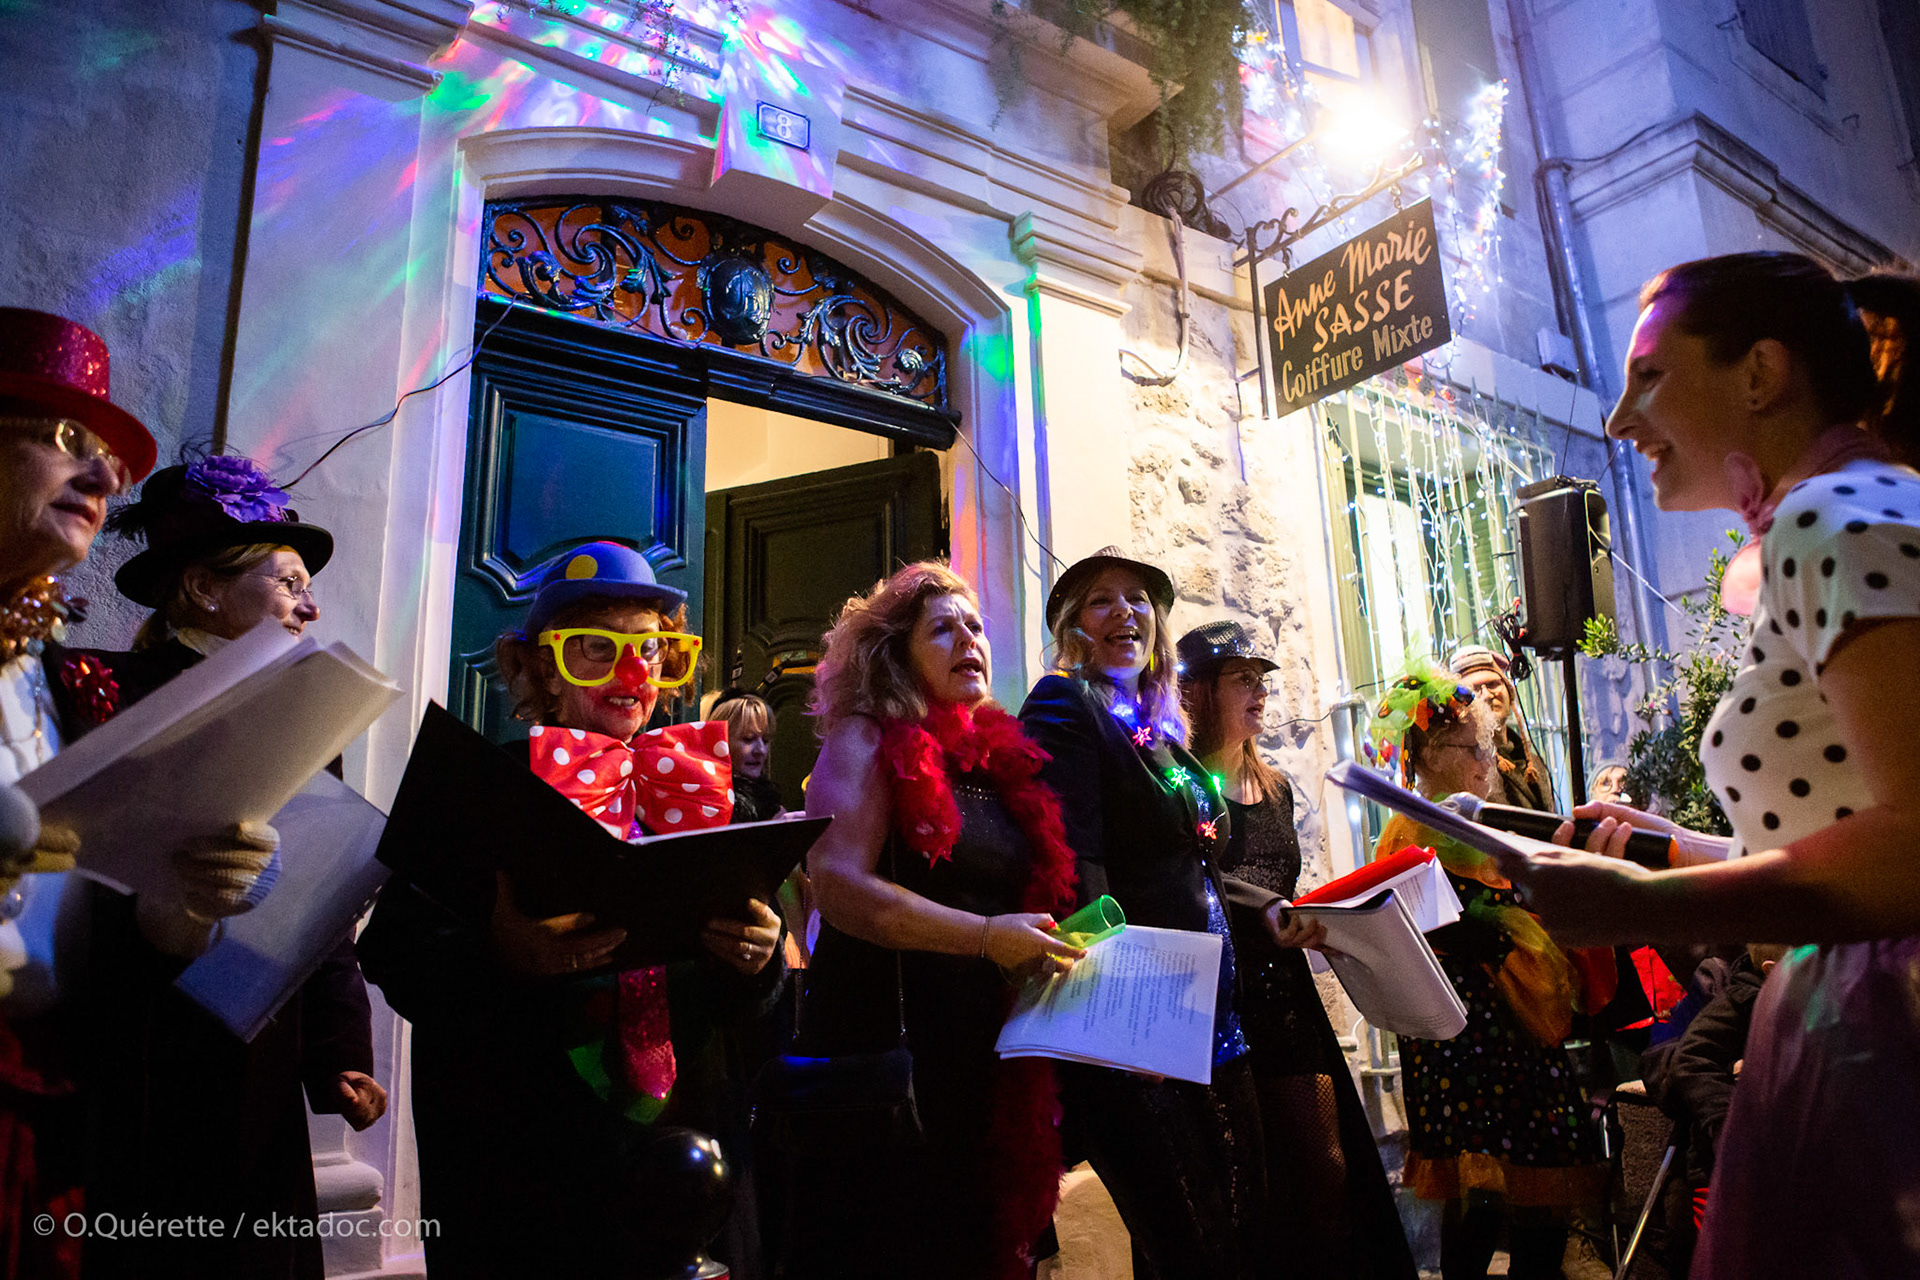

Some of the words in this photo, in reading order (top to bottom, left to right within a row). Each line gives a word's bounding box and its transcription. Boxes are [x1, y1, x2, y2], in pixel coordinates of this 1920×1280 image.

[776, 113, 792, 139] 8
[1274, 269, 1336, 351] Anne
[1340, 220, 1431, 294] Marie
[1312, 269, 1415, 353] SASSE
[1282, 345, 1363, 403] Coiffure
[1372, 314, 1434, 362] Mixte
